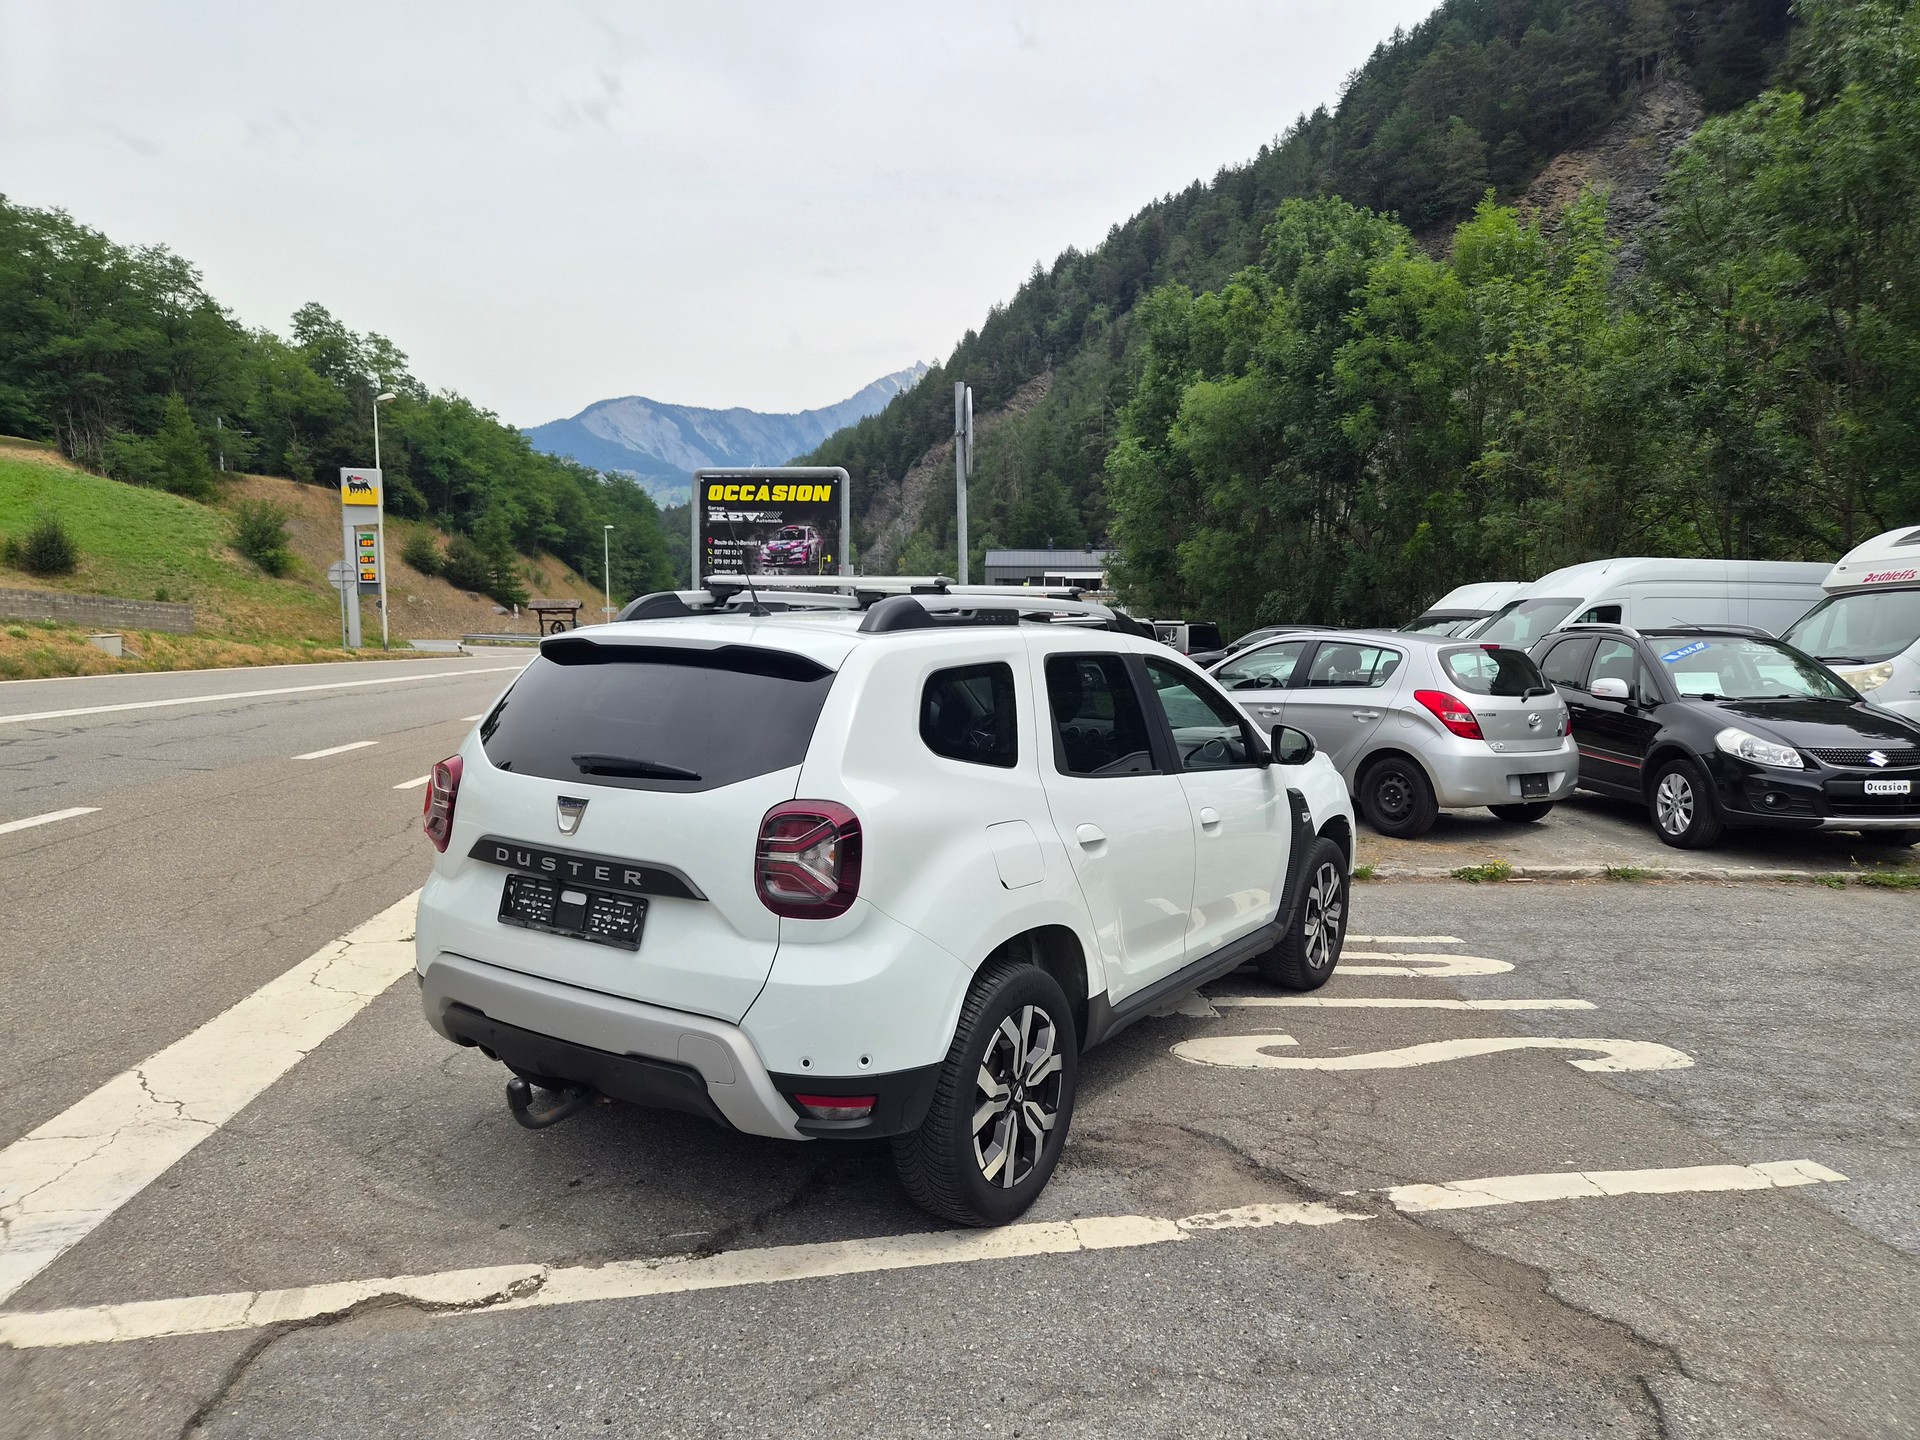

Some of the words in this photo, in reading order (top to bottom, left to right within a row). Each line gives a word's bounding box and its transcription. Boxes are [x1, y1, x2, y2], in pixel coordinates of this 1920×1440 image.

[707, 485, 832, 502] OCCASION
[1867, 782, 1908, 791] Occasion
[495, 846, 642, 886] DUSTER
